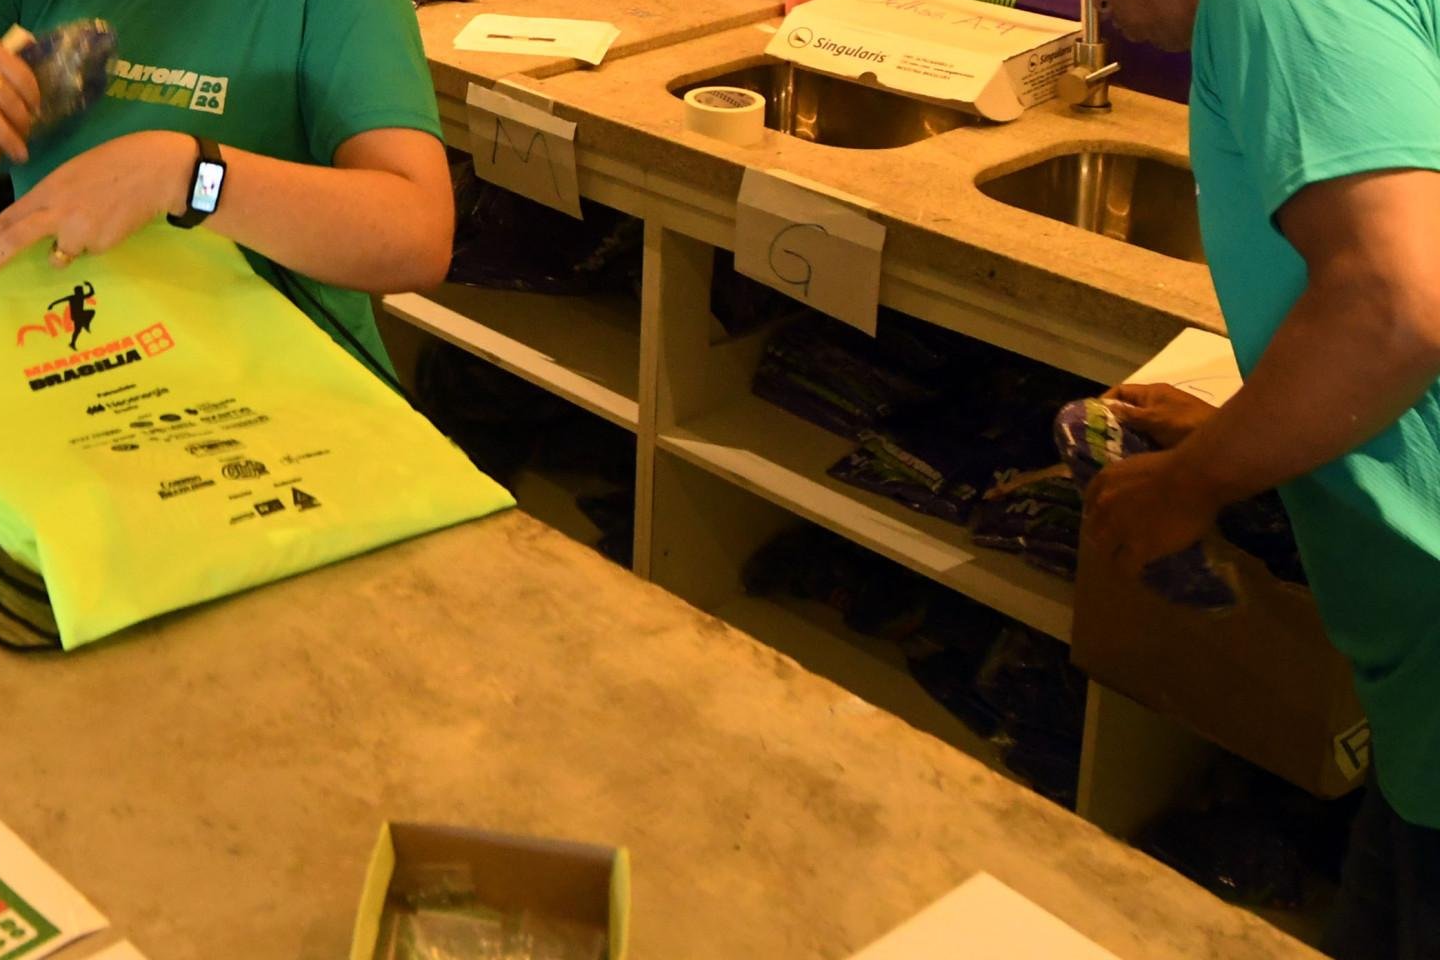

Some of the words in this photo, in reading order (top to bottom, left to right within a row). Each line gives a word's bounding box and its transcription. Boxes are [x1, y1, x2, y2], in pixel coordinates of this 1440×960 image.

[813, 36, 888, 65] Singularis
[200, 80, 223, 94] 20
[194, 94, 221, 109] 26
[491, 117, 562, 200] M
